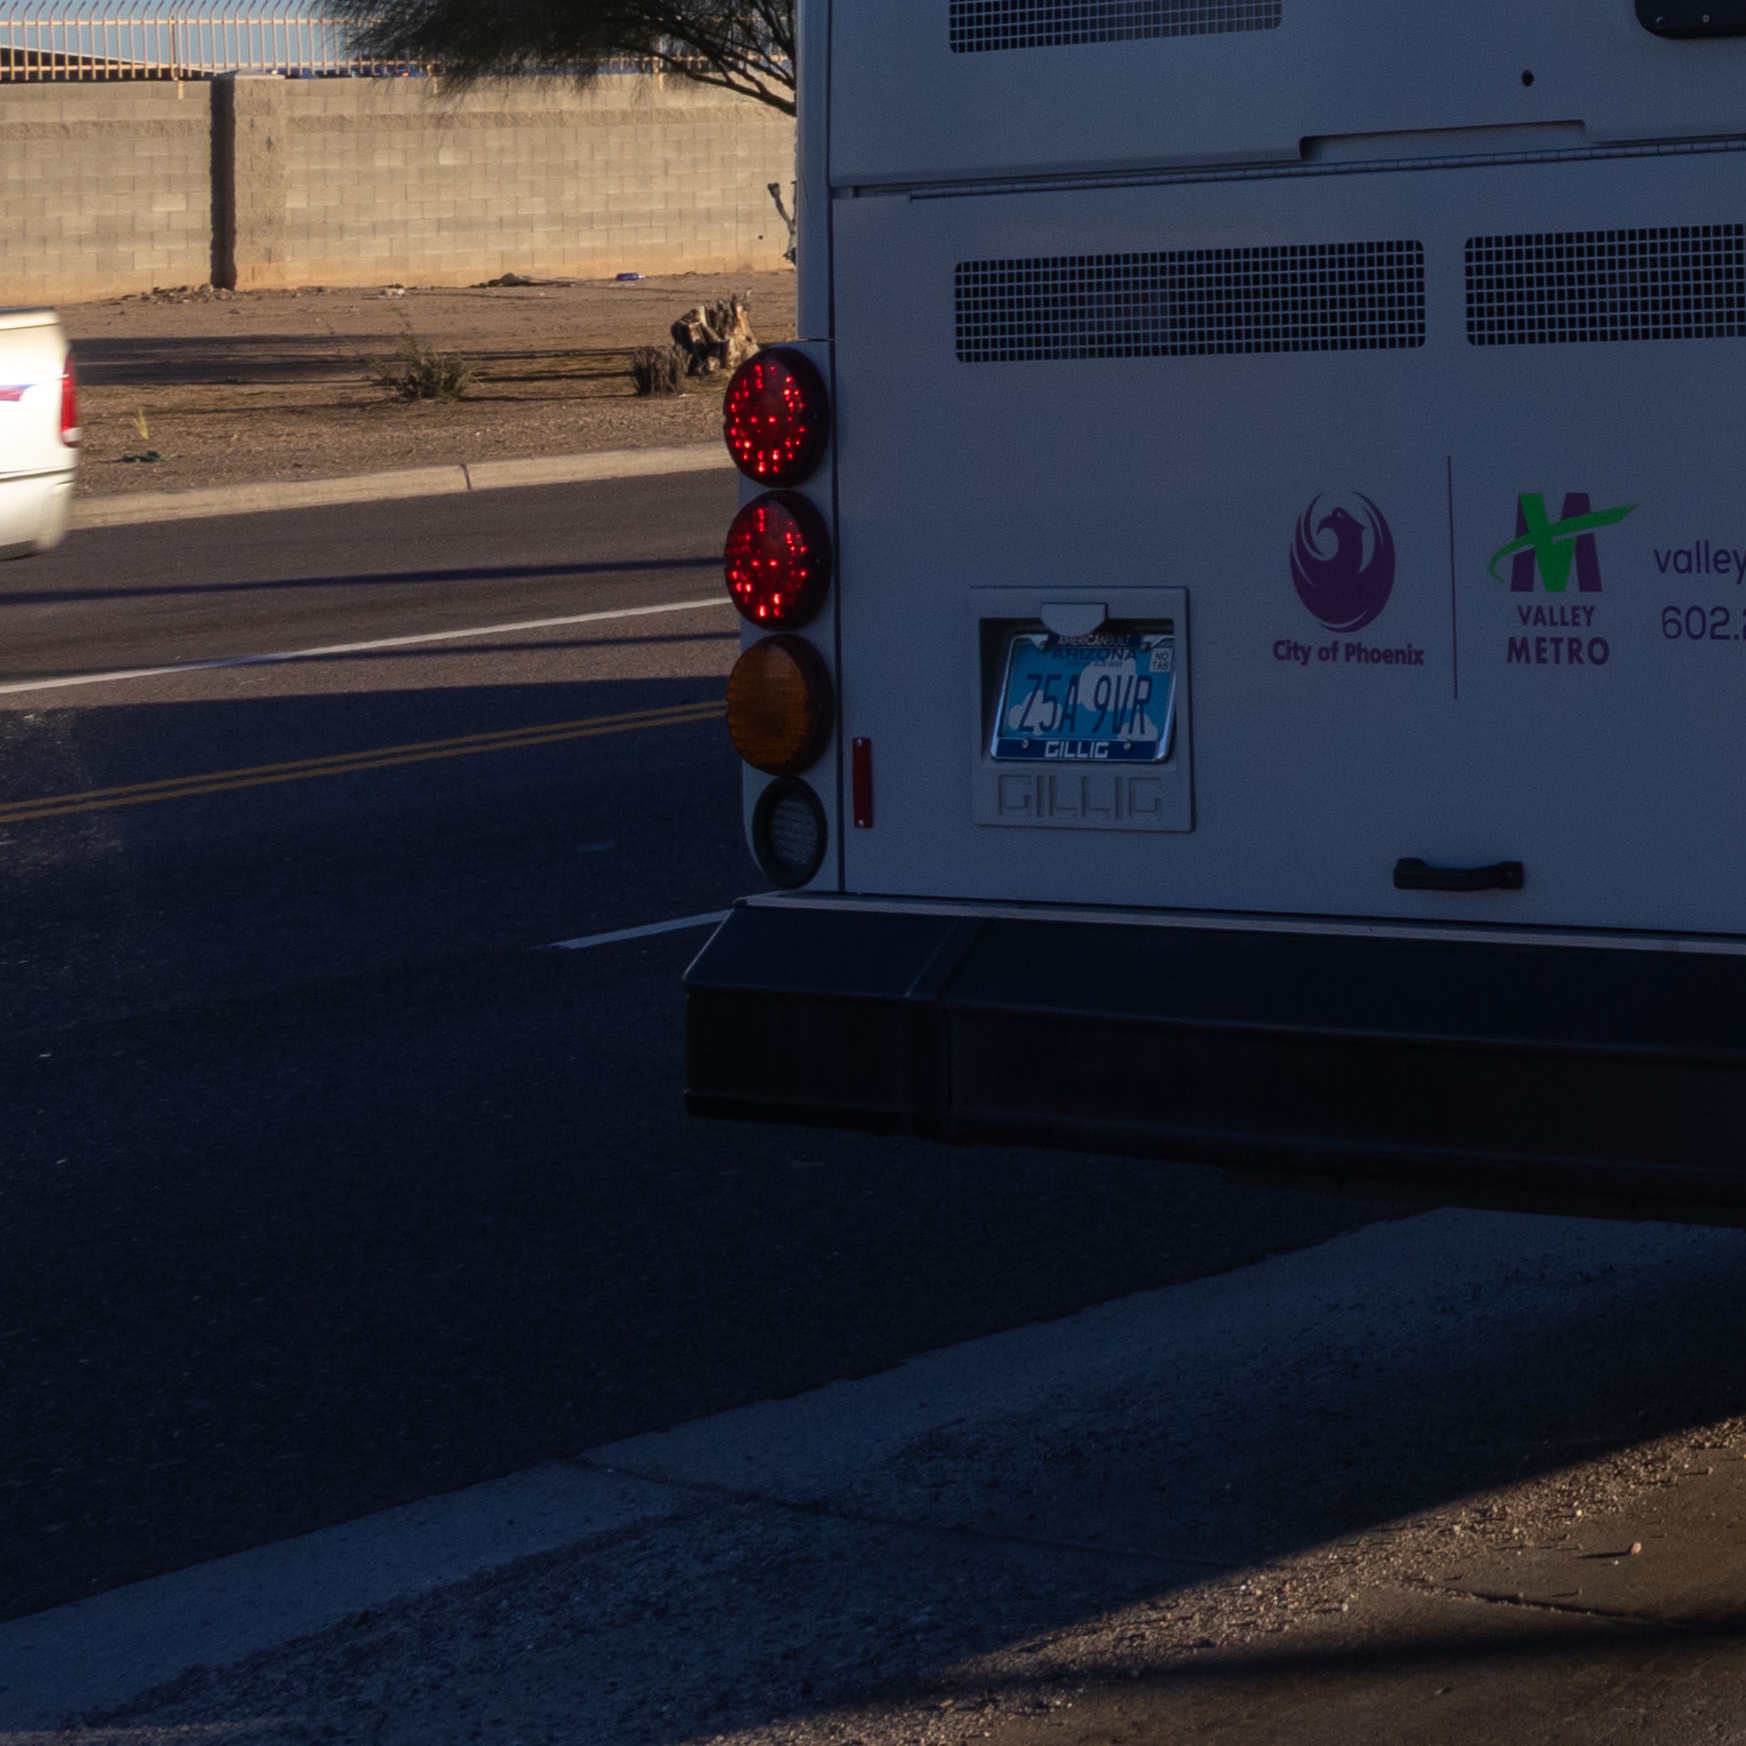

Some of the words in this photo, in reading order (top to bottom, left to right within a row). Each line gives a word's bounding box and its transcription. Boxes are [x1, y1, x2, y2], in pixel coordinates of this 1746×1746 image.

[1517, 605, 1596, 627] VALLEY
[1052, 649, 1137, 661] ARIZONA
[1156, 652, 1169, 661] NO
[1273, 640, 1312, 666] City
[1317, 641, 1340, 663] of
[1345, 642, 1425, 666] Phoenix
[1506, 636, 1610, 666] METRO
[1018, 674, 1079, 732] Z5A
[1092, 675, 1153, 735] 9VR
[1044, 741, 1110, 758] GILLIG
[999, 774, 1162, 821] GILLIG
